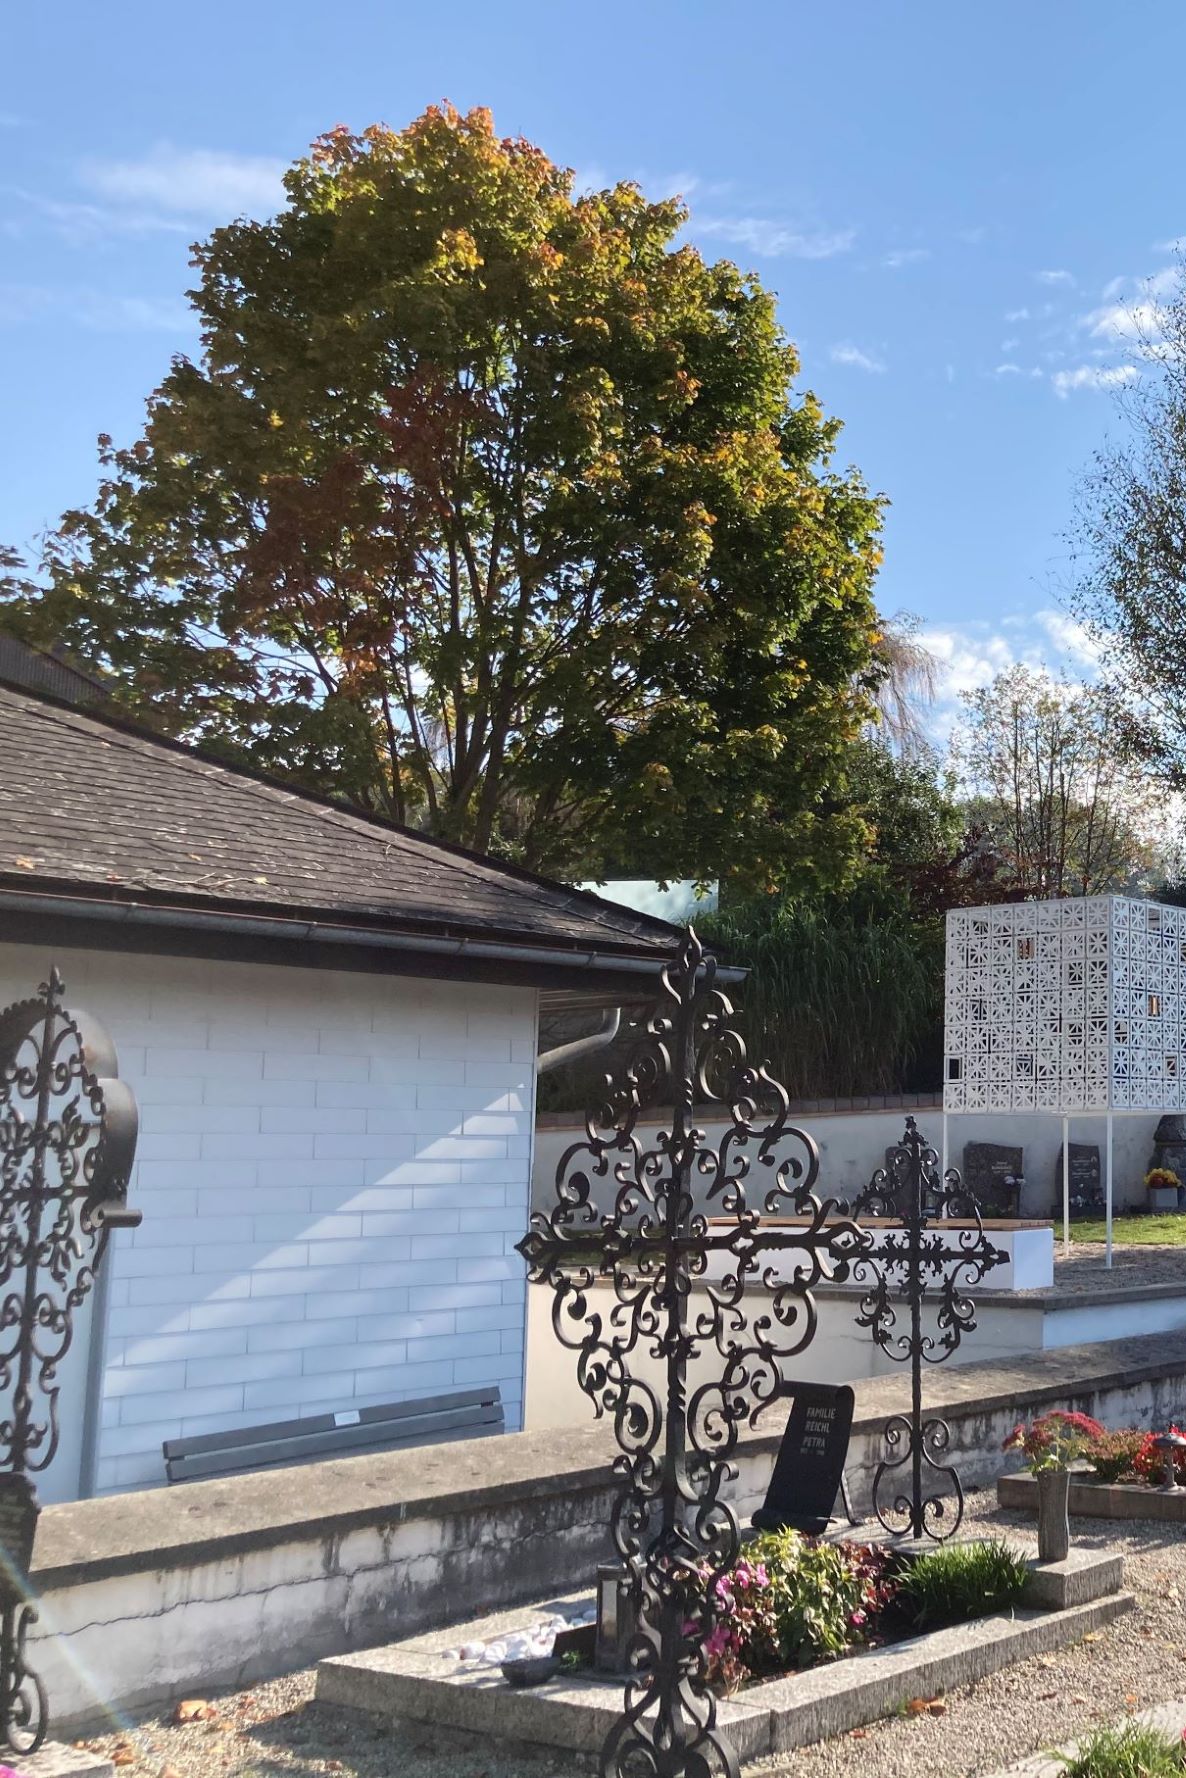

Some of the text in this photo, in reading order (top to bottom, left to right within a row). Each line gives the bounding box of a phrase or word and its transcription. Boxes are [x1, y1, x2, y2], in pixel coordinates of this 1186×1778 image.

[806, 1407, 836, 1419] FAMILIE
[804, 1421, 830, 1433] REICHL
[802, 1436, 825, 1448] PETRA
